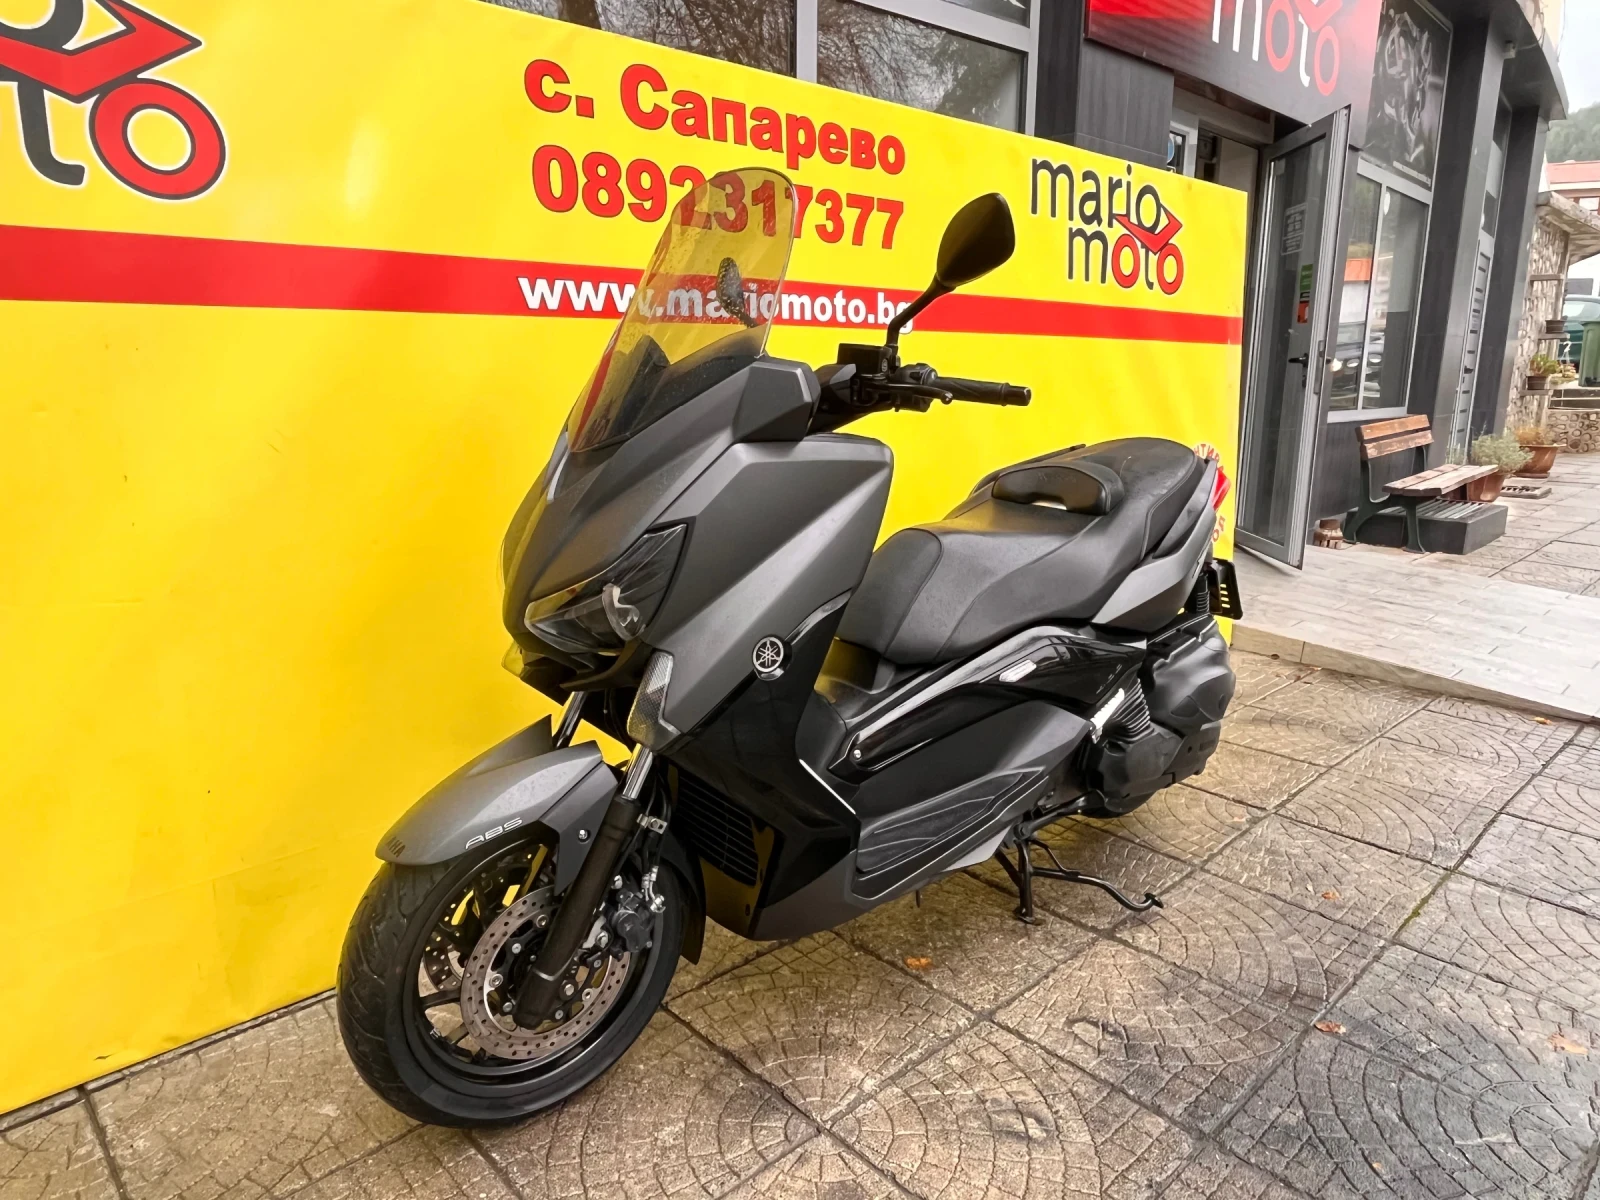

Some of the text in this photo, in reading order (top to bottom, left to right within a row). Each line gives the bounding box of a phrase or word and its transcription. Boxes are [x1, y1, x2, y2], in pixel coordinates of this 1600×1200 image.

[523, 59, 906, 176] с. Сапарево
[531, 144, 905, 250] 0892317377
[1030, 158, 1162, 236] mario
[1067, 227, 1185, 296] moto
[517, 276, 914, 335] www.maiomoto.bg
[465, 816, 523, 850] ABS
